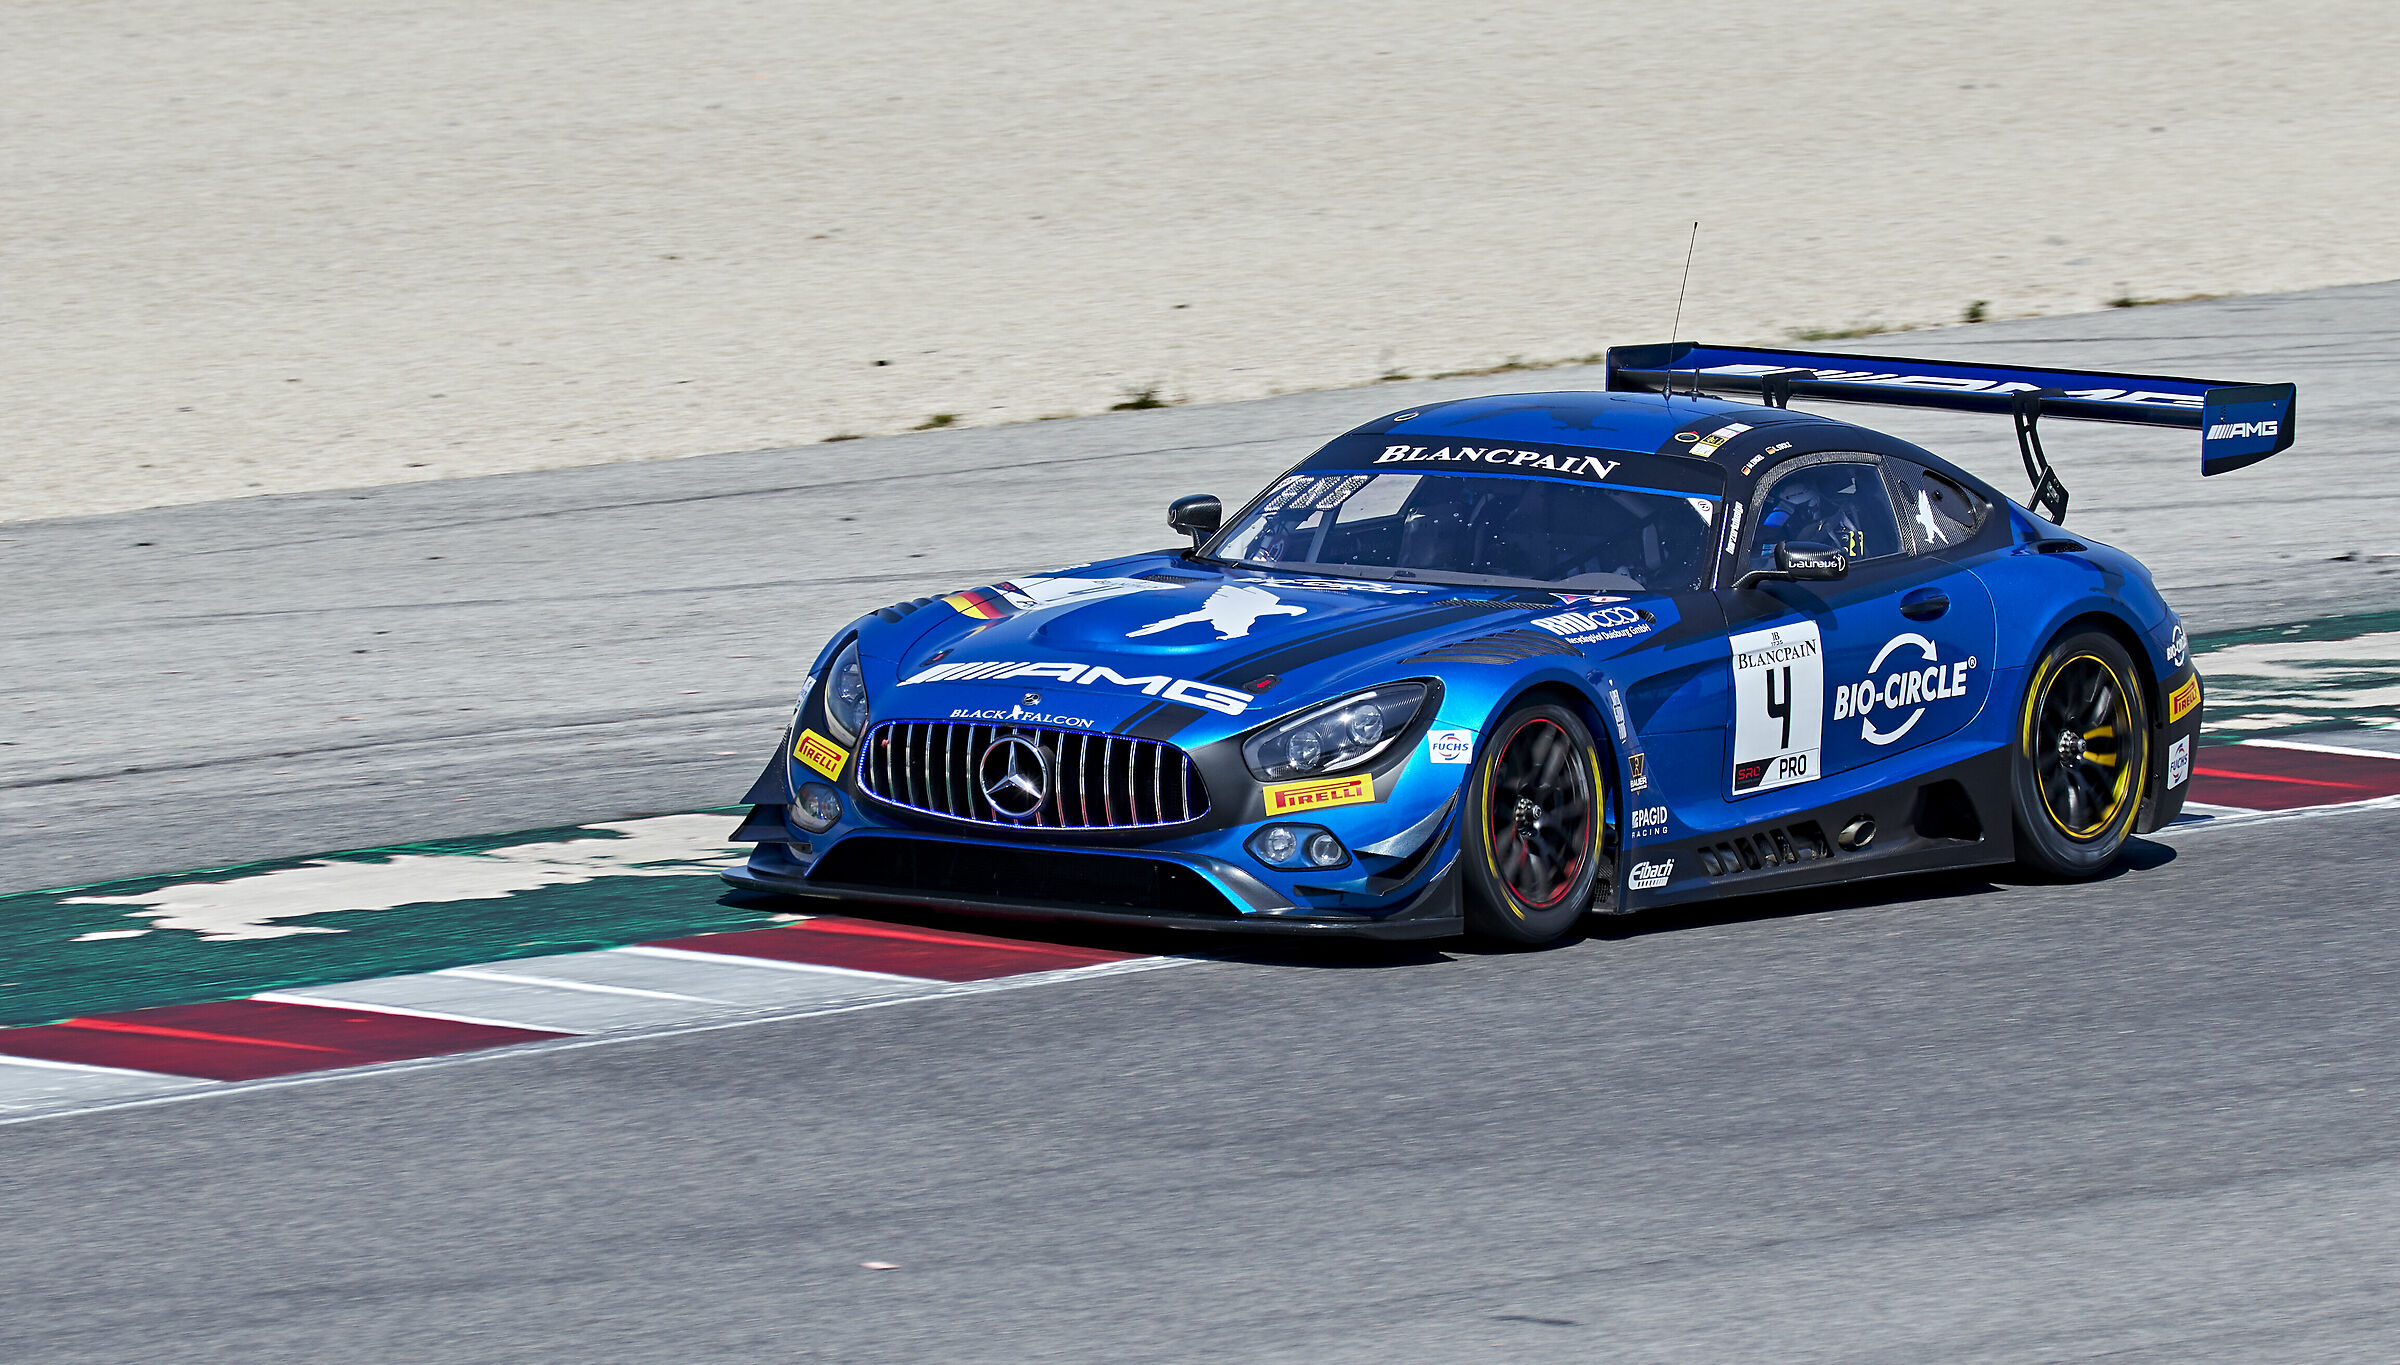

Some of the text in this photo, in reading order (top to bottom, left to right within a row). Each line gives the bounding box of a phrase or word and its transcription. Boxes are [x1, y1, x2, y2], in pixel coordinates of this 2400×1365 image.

[2228, 421, 2278, 439] AMG
[1373, 445, 1620, 479] BLANCPAIN
[1629, 623, 1652, 637] GmbH
[1738, 639, 1817, 669] BLANCPAIN
[992, 662, 1255, 716] AMG
[950, 708, 1095, 729] BLACK FALCON
[1766, 665, 1792, 750] 4
[799, 735, 842, 773] PIRELLI
[1432, 742, 1469, 752] FUCHS
[1738, 765, 1761, 781] SRO
[1779, 754, 1807, 780] PRO
[2170, 757, 2188, 773] FUCHS
[1275, 780, 1364, 808] PIRELLI
[1638, 805, 1668, 828] PAGID
[1632, 826, 1668, 839] RACING
[1628, 858, 1675, 889] Eibach
